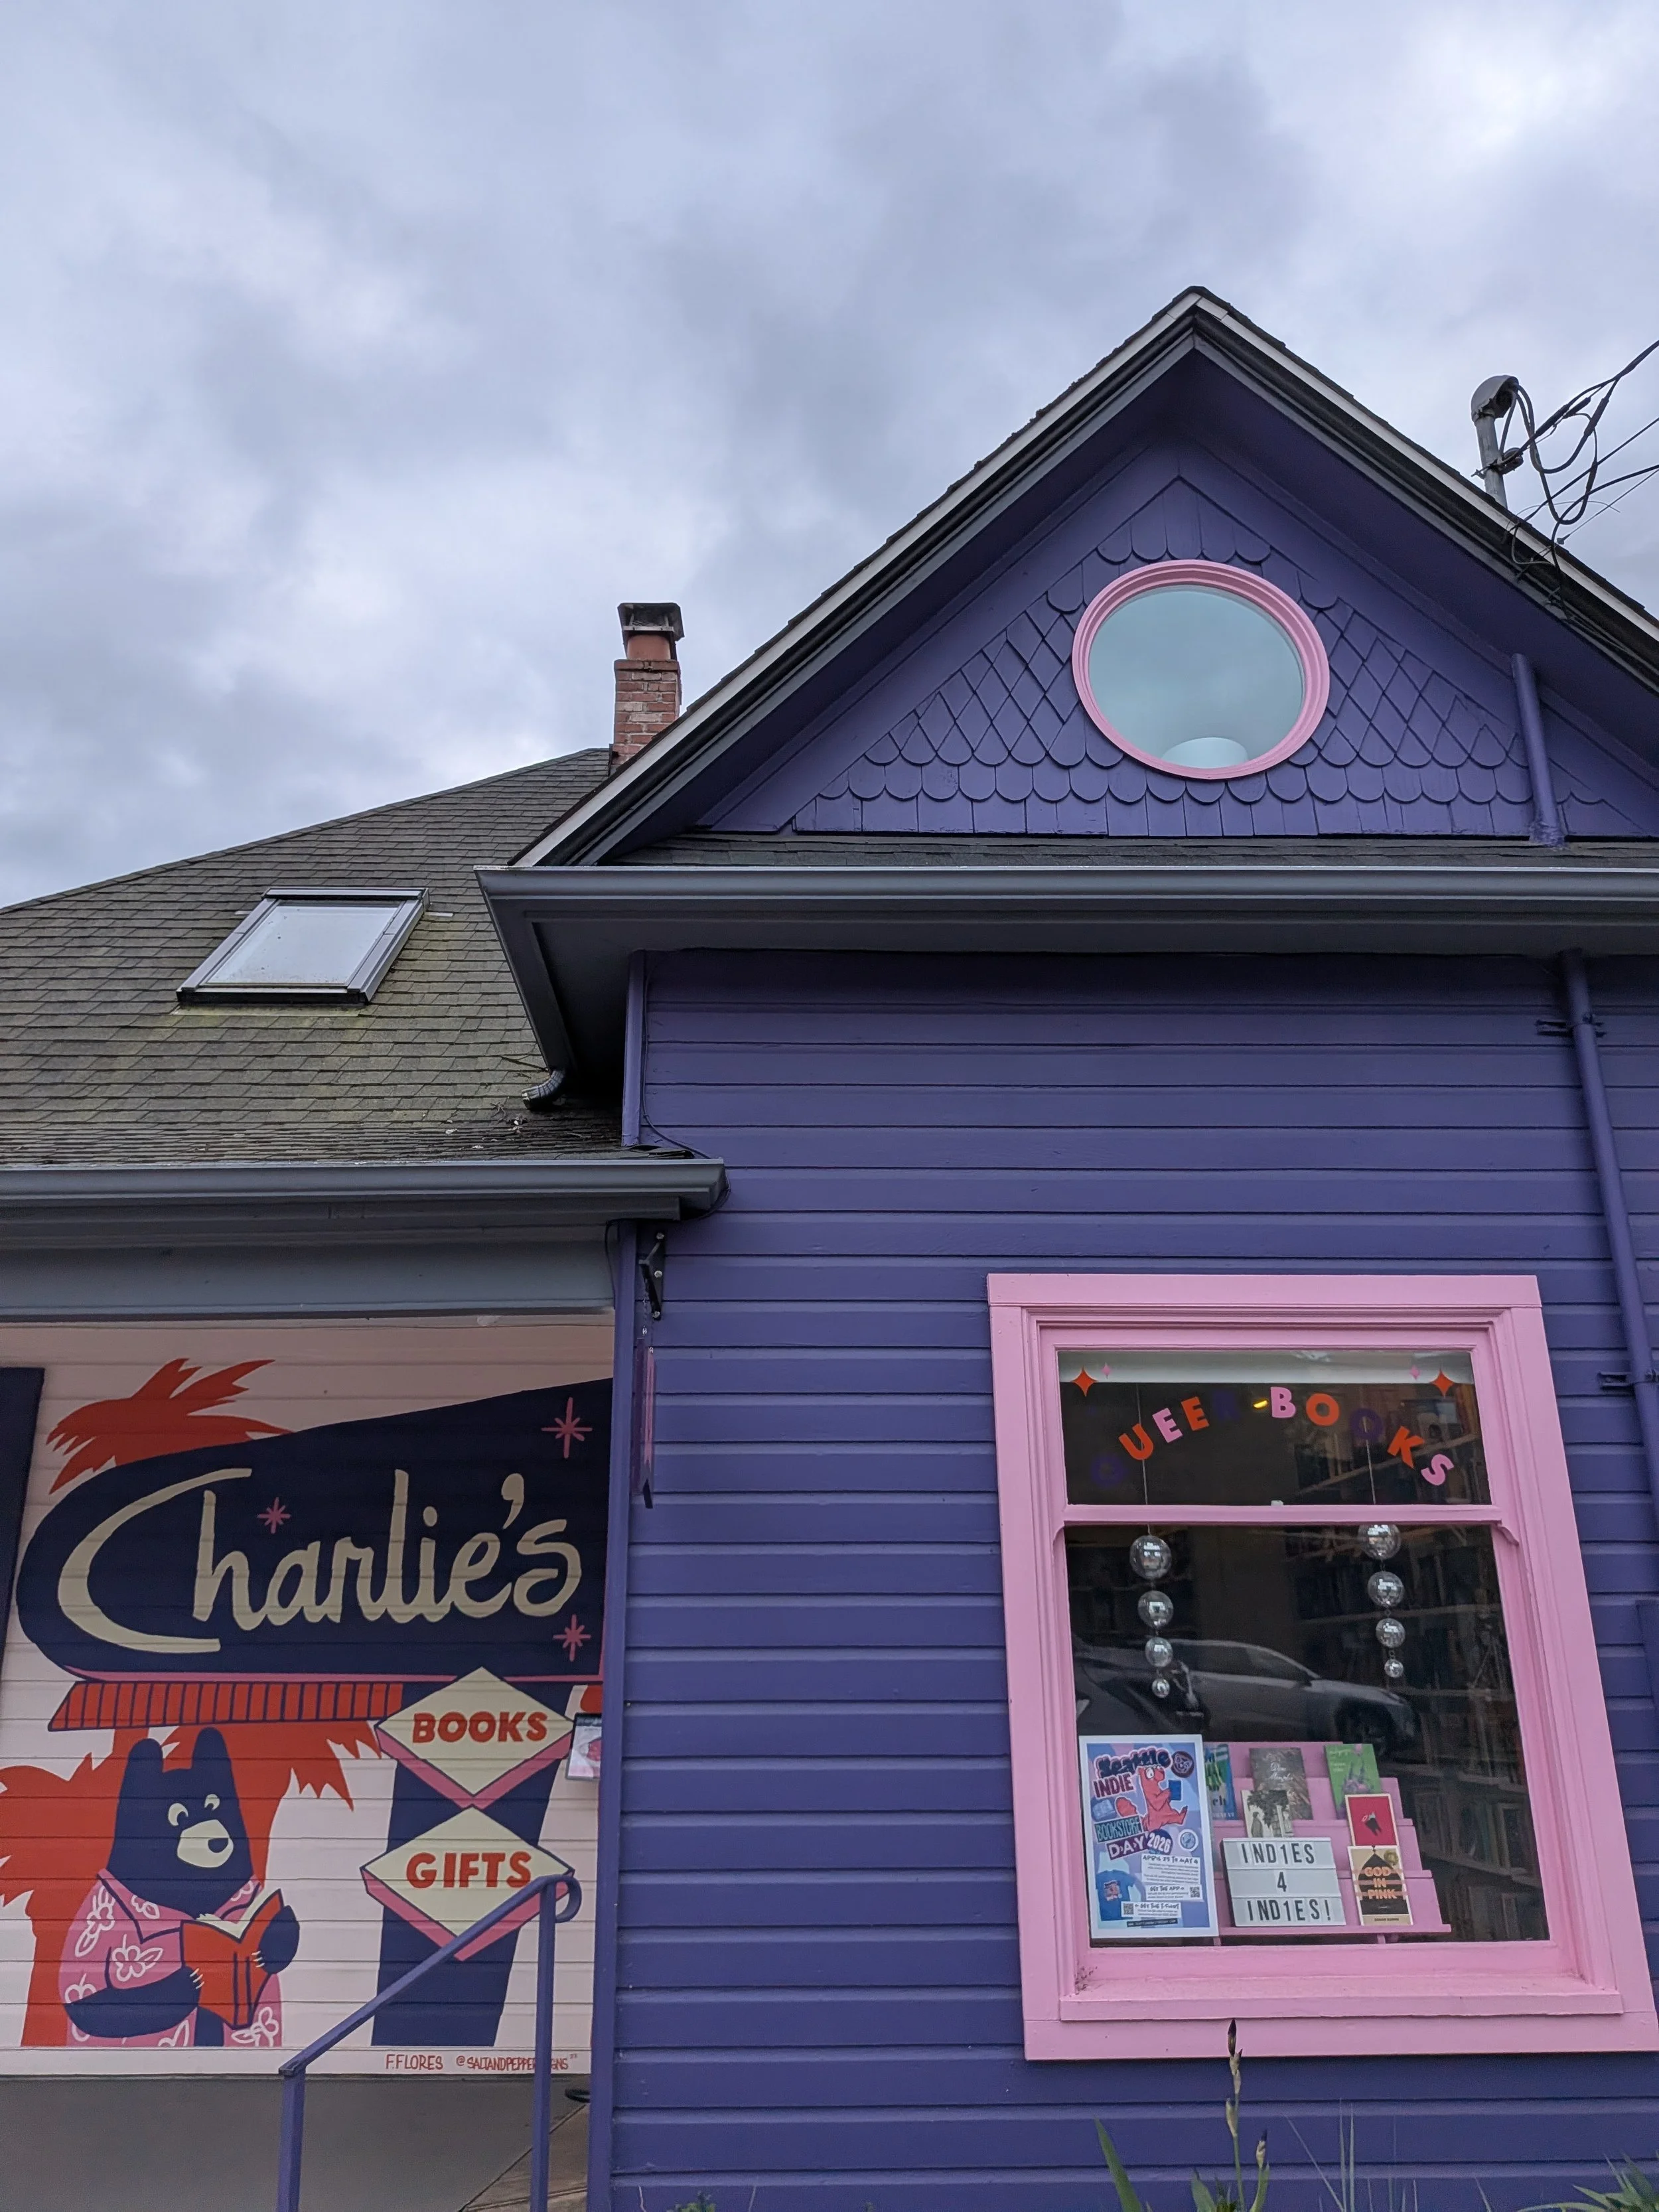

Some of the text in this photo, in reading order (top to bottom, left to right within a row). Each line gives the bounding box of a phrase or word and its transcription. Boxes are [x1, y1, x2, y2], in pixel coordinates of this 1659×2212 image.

[1269, 1386, 1455, 1487] BOOKS
[58, 1468, 582, 1654] Charlie's
[412, 1711, 548, 1743] BOOKS
[1097, 1747, 1171, 1777] Seattle
[1094, 1774, 1134, 1798] INDIE
[1096, 1817, 1142, 1840] BOOKSTORE
[1147, 1832, 1171, 1853] 2026
[405, 1851, 532, 1888] GIFTS
[1364, 1866, 1392, 1877] GOD
[1277, 1872, 1287, 1892] 4
[1373, 1878, 1387, 1887] IN
[1367, 1889, 1398, 1899] PINK
